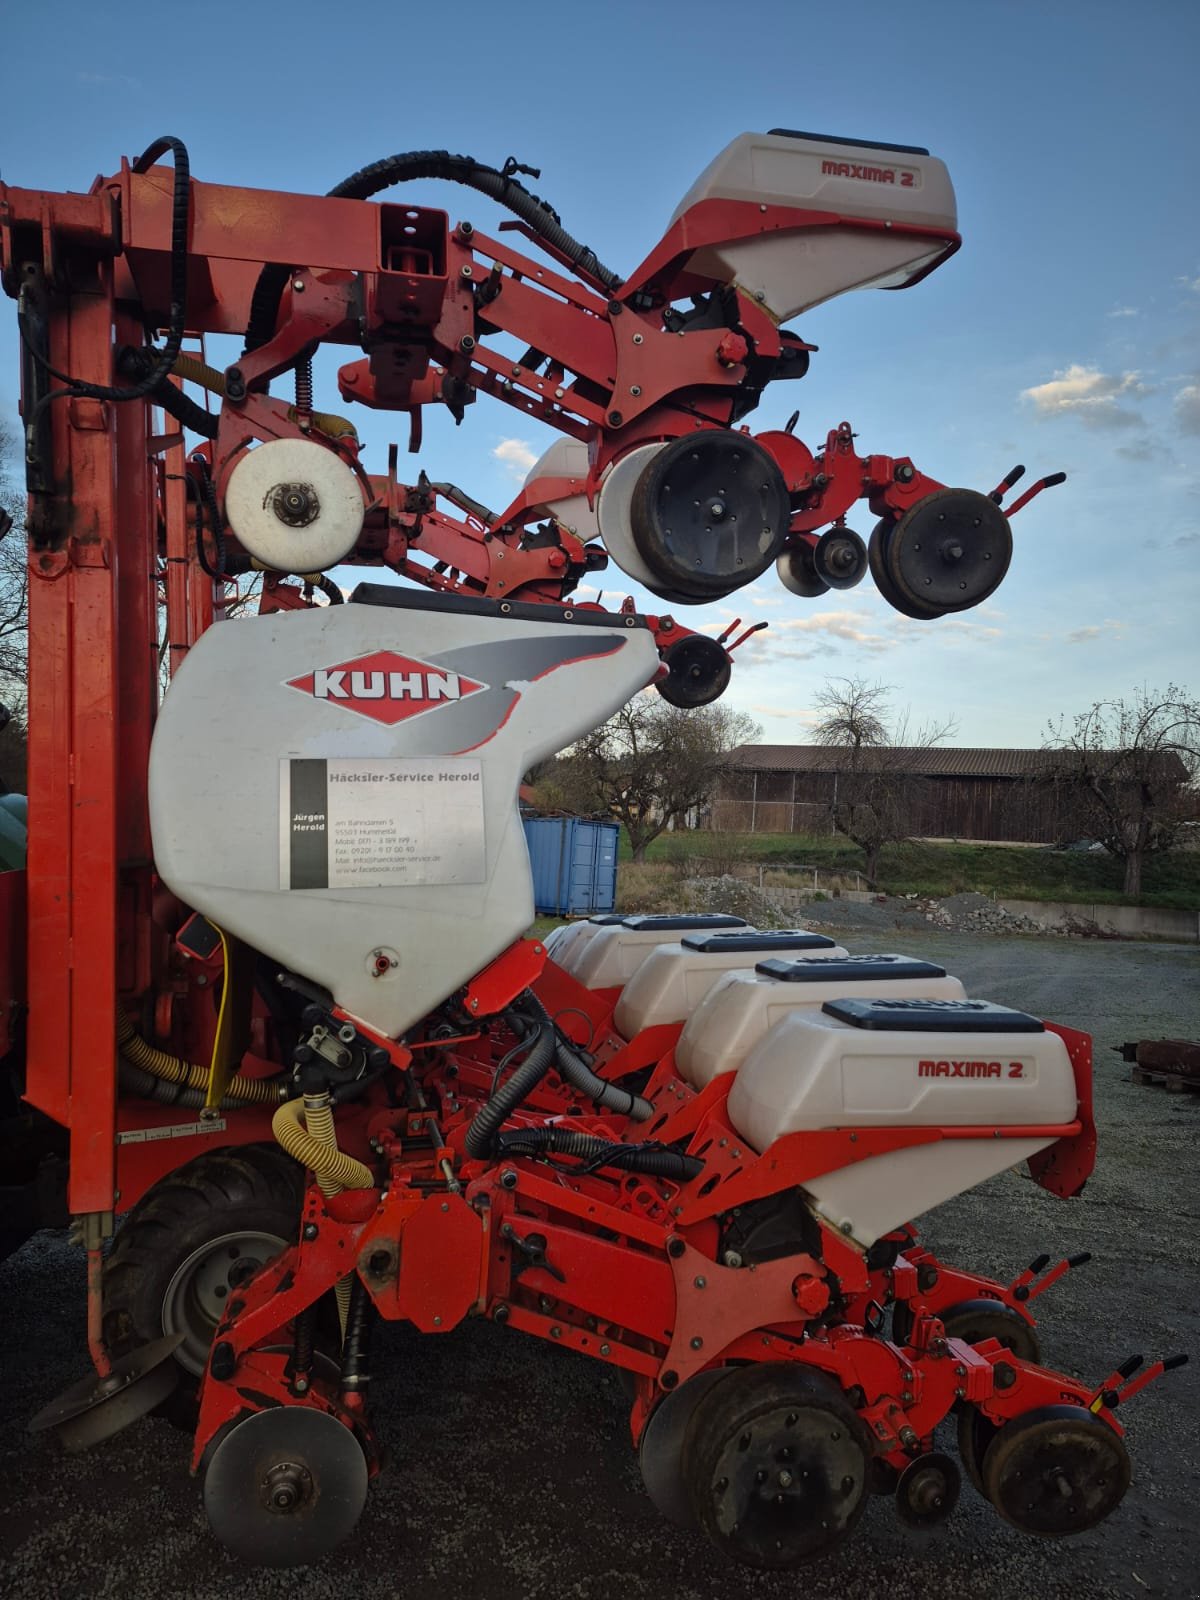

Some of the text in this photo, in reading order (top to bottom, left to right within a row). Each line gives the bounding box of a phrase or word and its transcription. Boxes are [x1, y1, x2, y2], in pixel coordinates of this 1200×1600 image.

[822, 160, 914, 187] MAXIMA 2
[313, 669, 461, 700] KUHN
[329, 772, 480, 783] Häcksler-Service Herold
[293, 813, 325, 822] Jürgen
[293, 823, 325, 831] Herold
[918, 1060, 1024, 1078] MAXIMA 2
